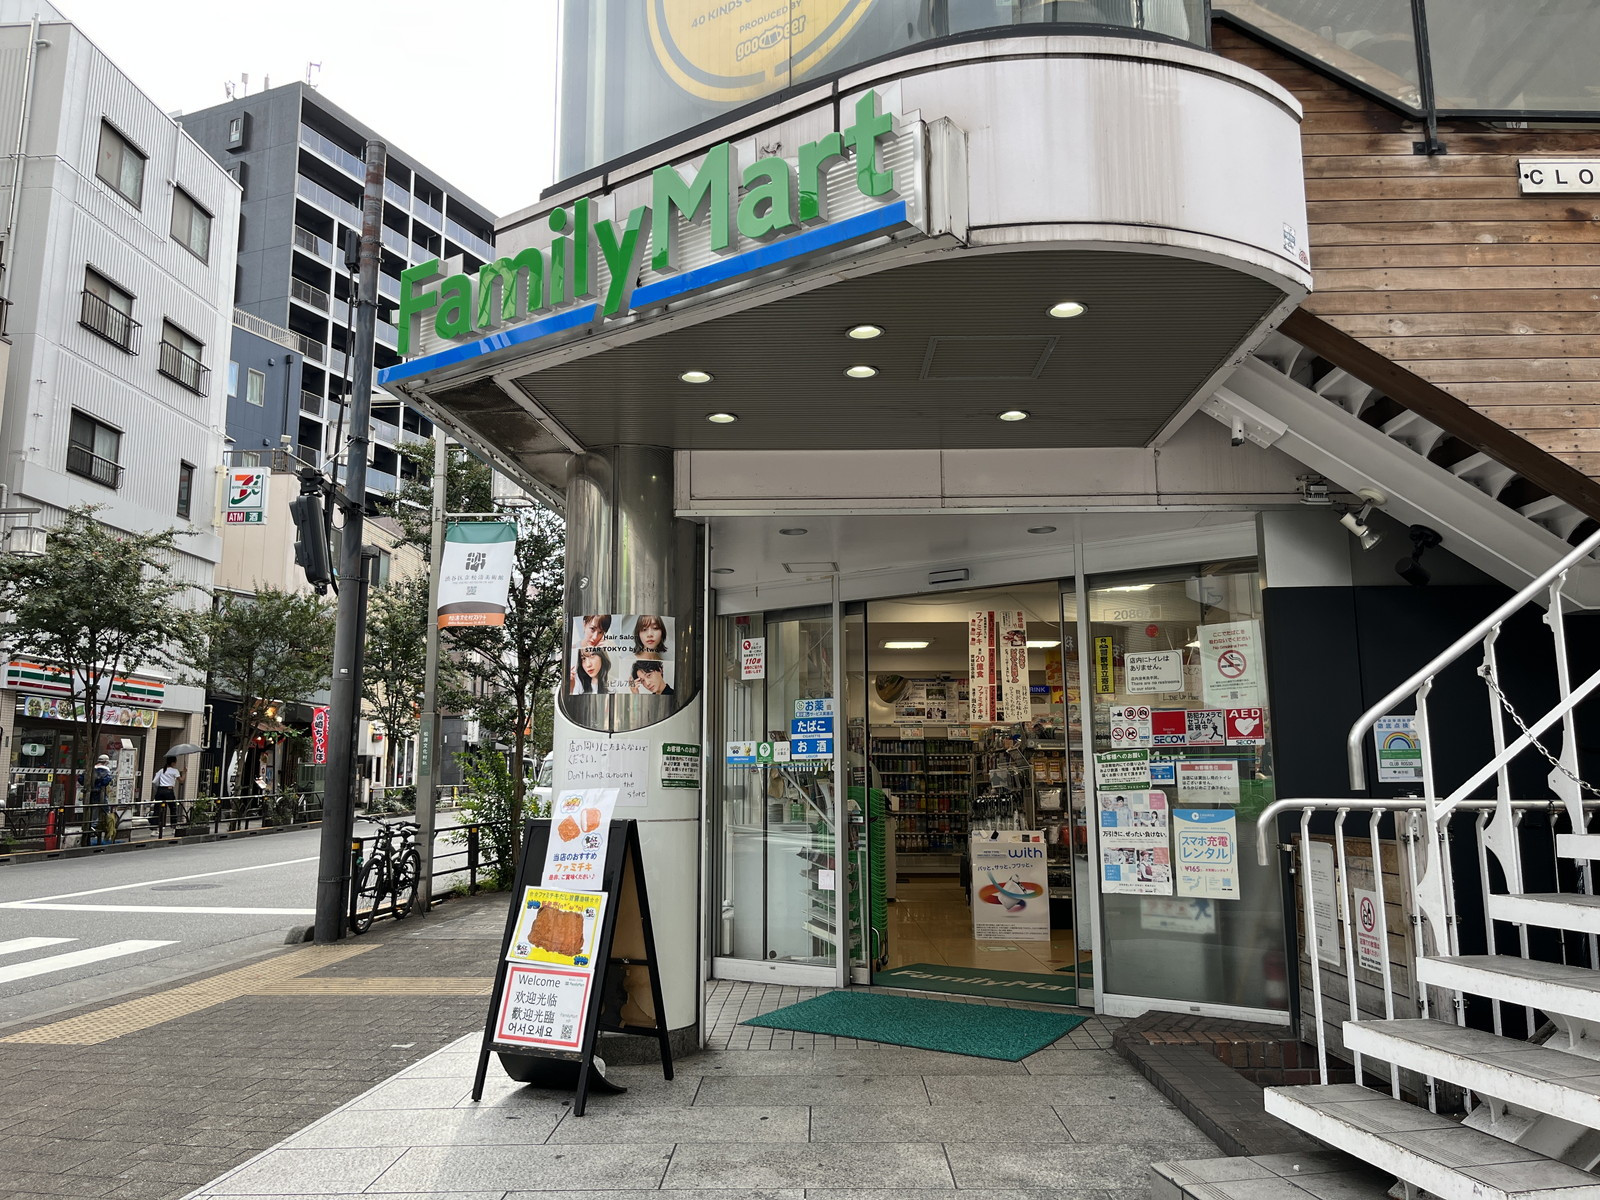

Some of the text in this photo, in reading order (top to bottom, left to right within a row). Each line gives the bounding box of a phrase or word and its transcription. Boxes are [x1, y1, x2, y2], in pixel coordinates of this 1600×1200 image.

[739, 5, 788, 33] PRODUCED
[398, 89, 900, 356] FamilyMart
[228, 513, 244, 522] ATM
[248, 512, 259, 522] 酒
[1129, 655, 1170, 664] 店内にトイレは
[1130, 664, 1162, 672] ありません。
[804, 700, 824, 711] お薬
[1187, 711, 1222, 719] 防犯カメラで
[1229, 708, 1260, 718] AED
[797, 720, 826, 732] たばこ
[1154, 735, 1186, 744] SECOM
[1101, 752, 1144, 761] お客様へのお願い
[586, 770, 603, 780] hang
[606, 771, 633, 779] around
[627, 790, 646, 798] store
[1102, 830, 1167, 838] 万引きに、ぜったい負けない。
[1182, 836, 1229, 847] スマホ充電
[553, 853, 597, 861] 当店のおすすめ
[1008, 846, 1043, 858] with
[1183, 847, 1229, 859] レンタル
[555, 863, 592, 872] ファミチキ
[518, 974, 561, 988] Welcome
[514, 990, 558, 1007] 欢迎光临
[511, 1006, 555, 1024] 歡迎光臨
[508, 1022, 553, 1037] 어서오세요
